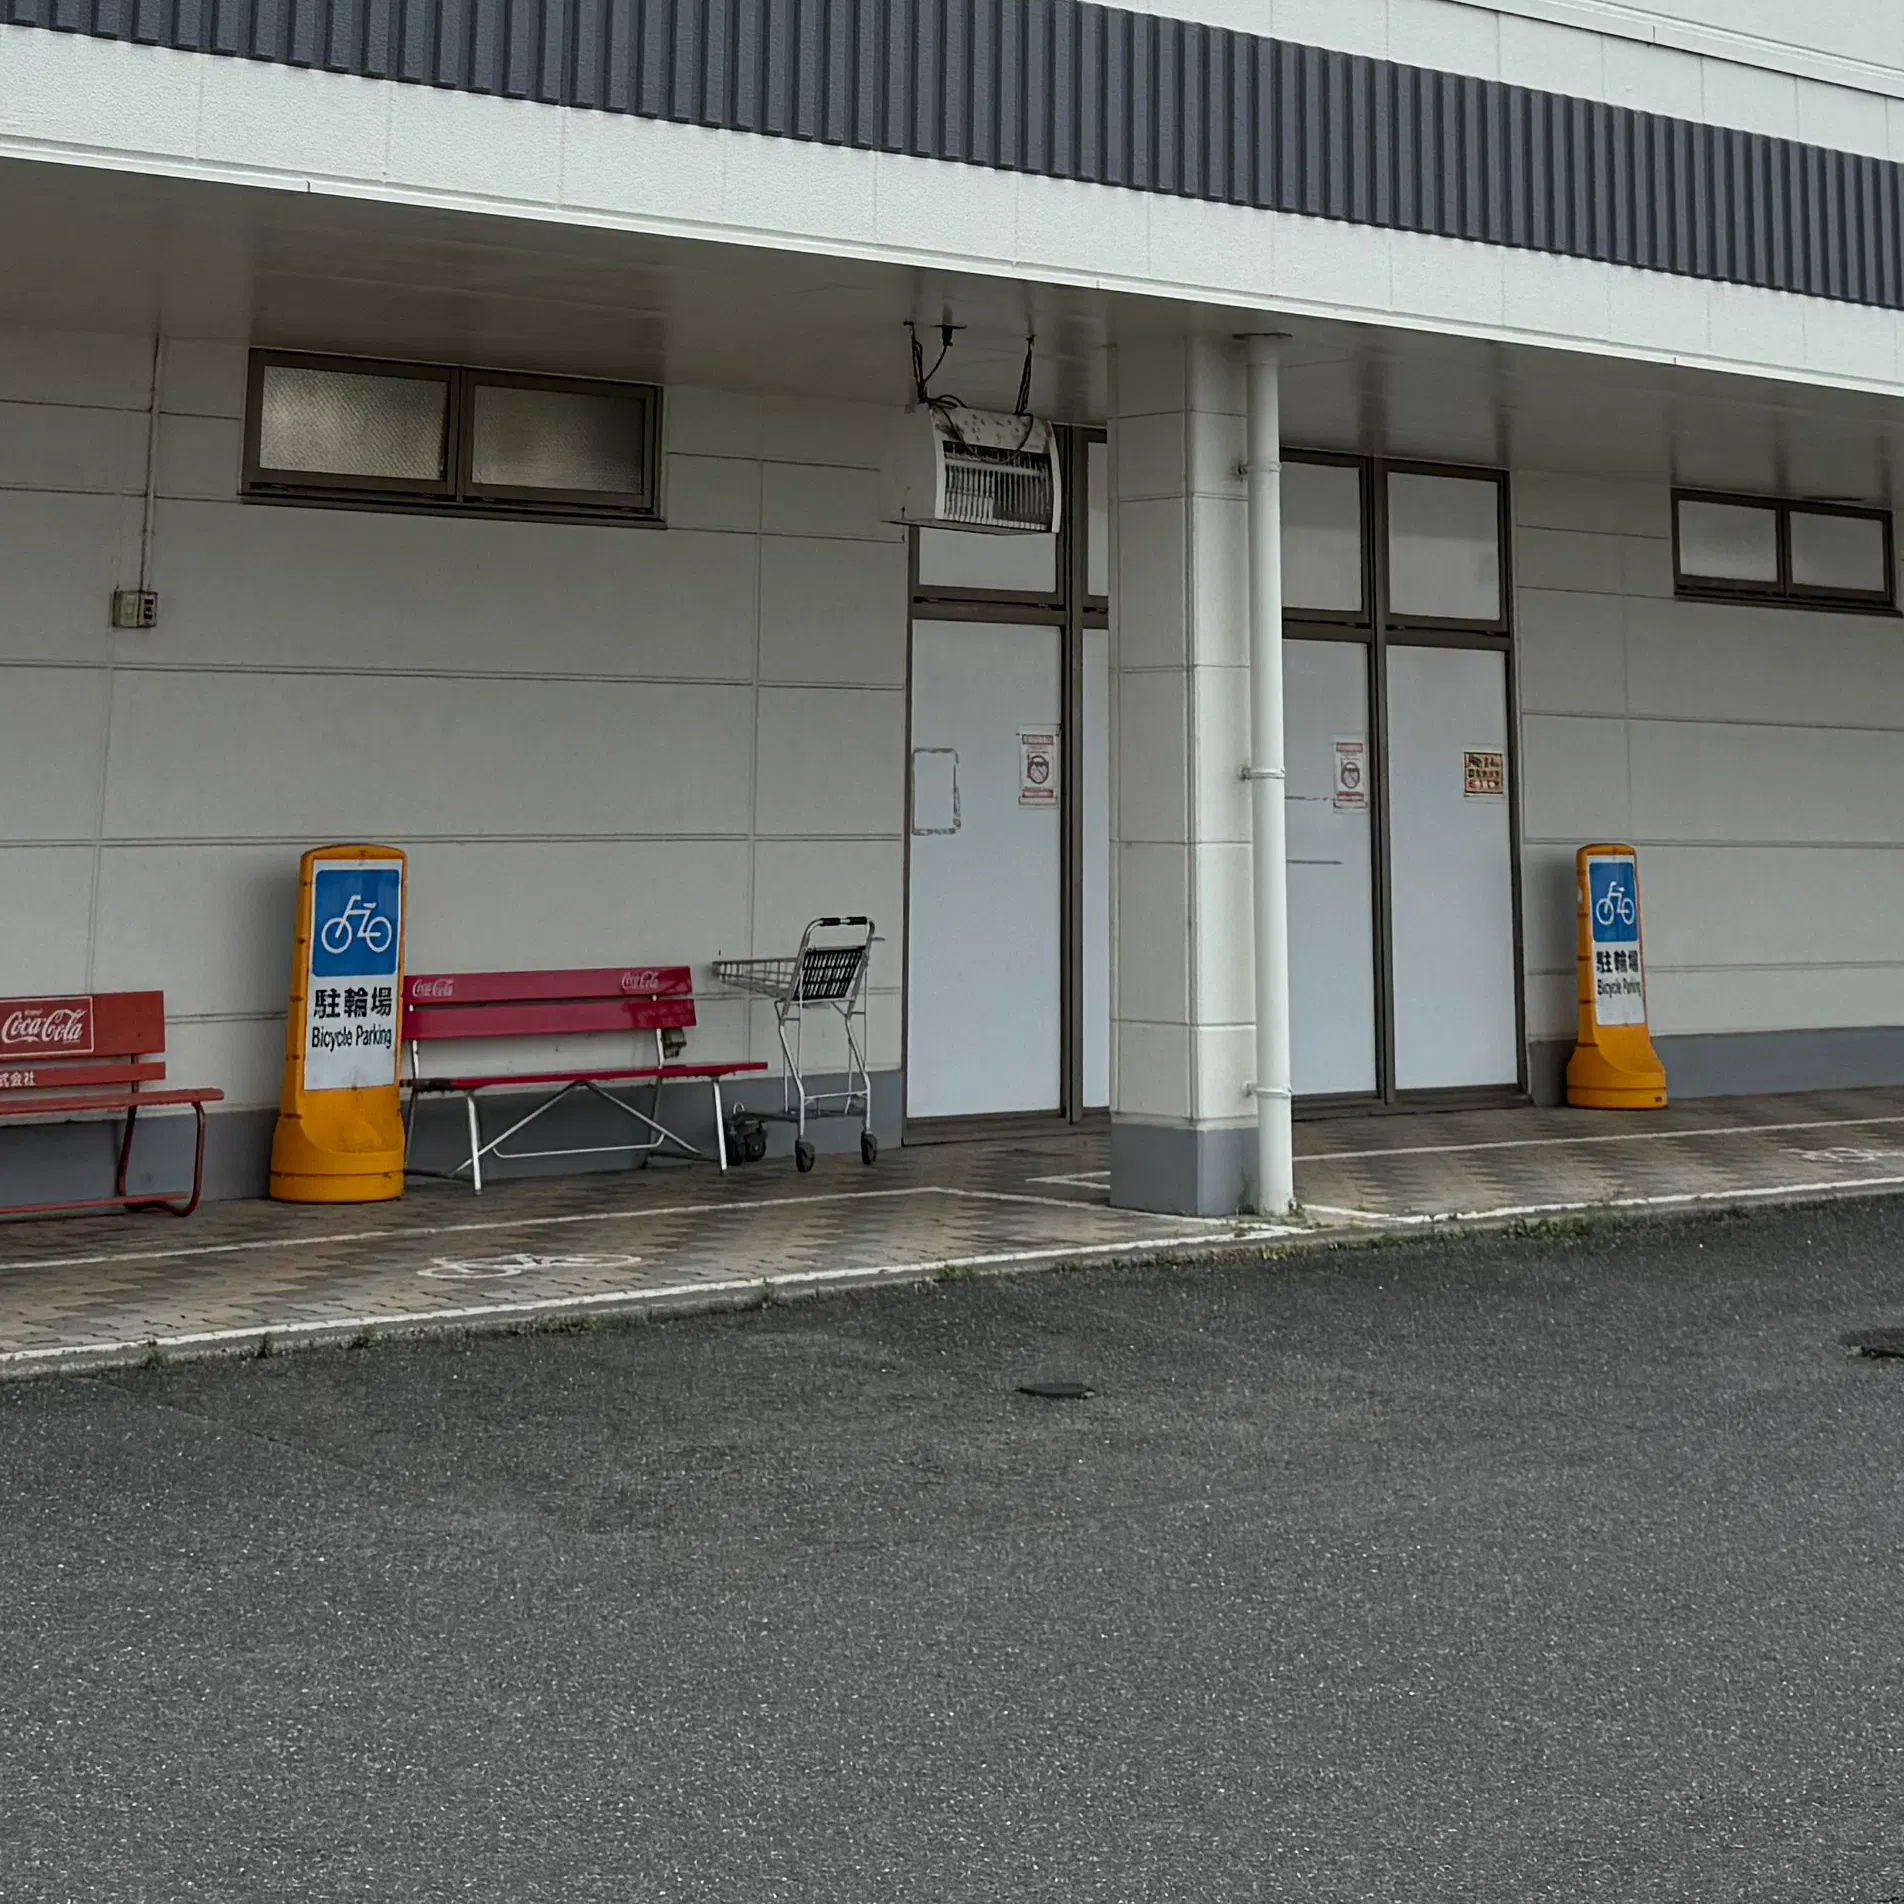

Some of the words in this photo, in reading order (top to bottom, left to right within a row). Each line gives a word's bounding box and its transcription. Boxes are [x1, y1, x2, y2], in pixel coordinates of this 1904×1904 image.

[313, 986, 392, 1019] 駐輪場
[311, 1025, 353, 1053] Bicycle
[356, 1022, 392, 1050] Parking
